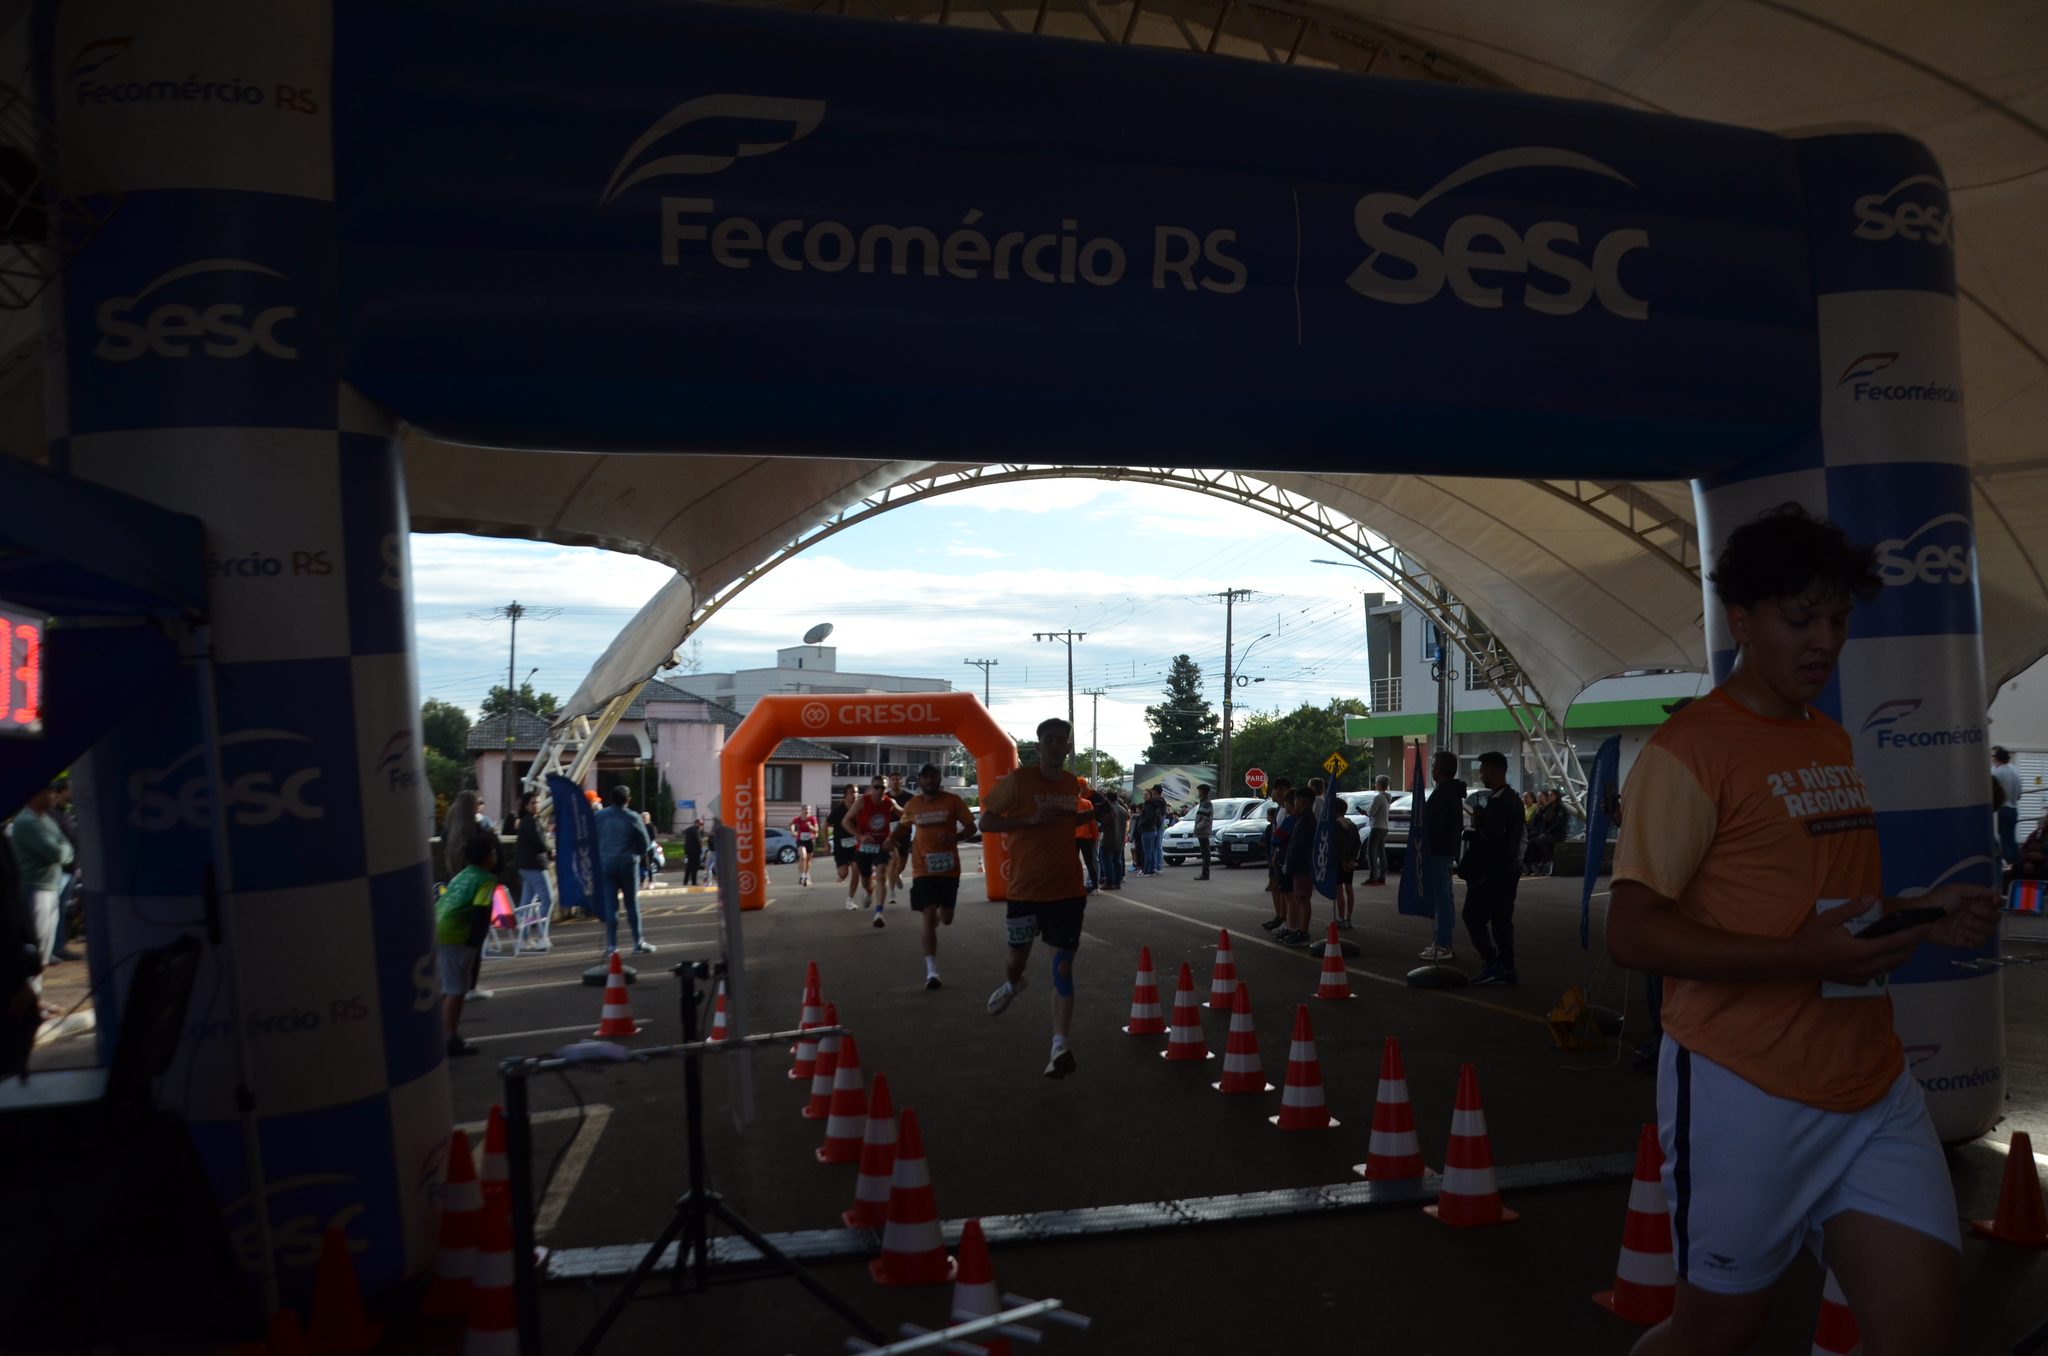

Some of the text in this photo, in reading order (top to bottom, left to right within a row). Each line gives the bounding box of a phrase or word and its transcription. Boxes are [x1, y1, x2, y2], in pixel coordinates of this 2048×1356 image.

[78, 74, 318, 114] Fecomércio RS
[660, 196, 1248, 294] Fecomércio RS
[1345, 191, 1650, 320] Sesc
[94, 296, 298, 362] Sesc
[204, 550, 333, 578] ércio RS
[838, 703, 941, 725] CRESOL
[735, 777, 754, 865] CRESOL
[1007, 925, 1035, 941] 250
[328, 995, 369, 1025] RS
